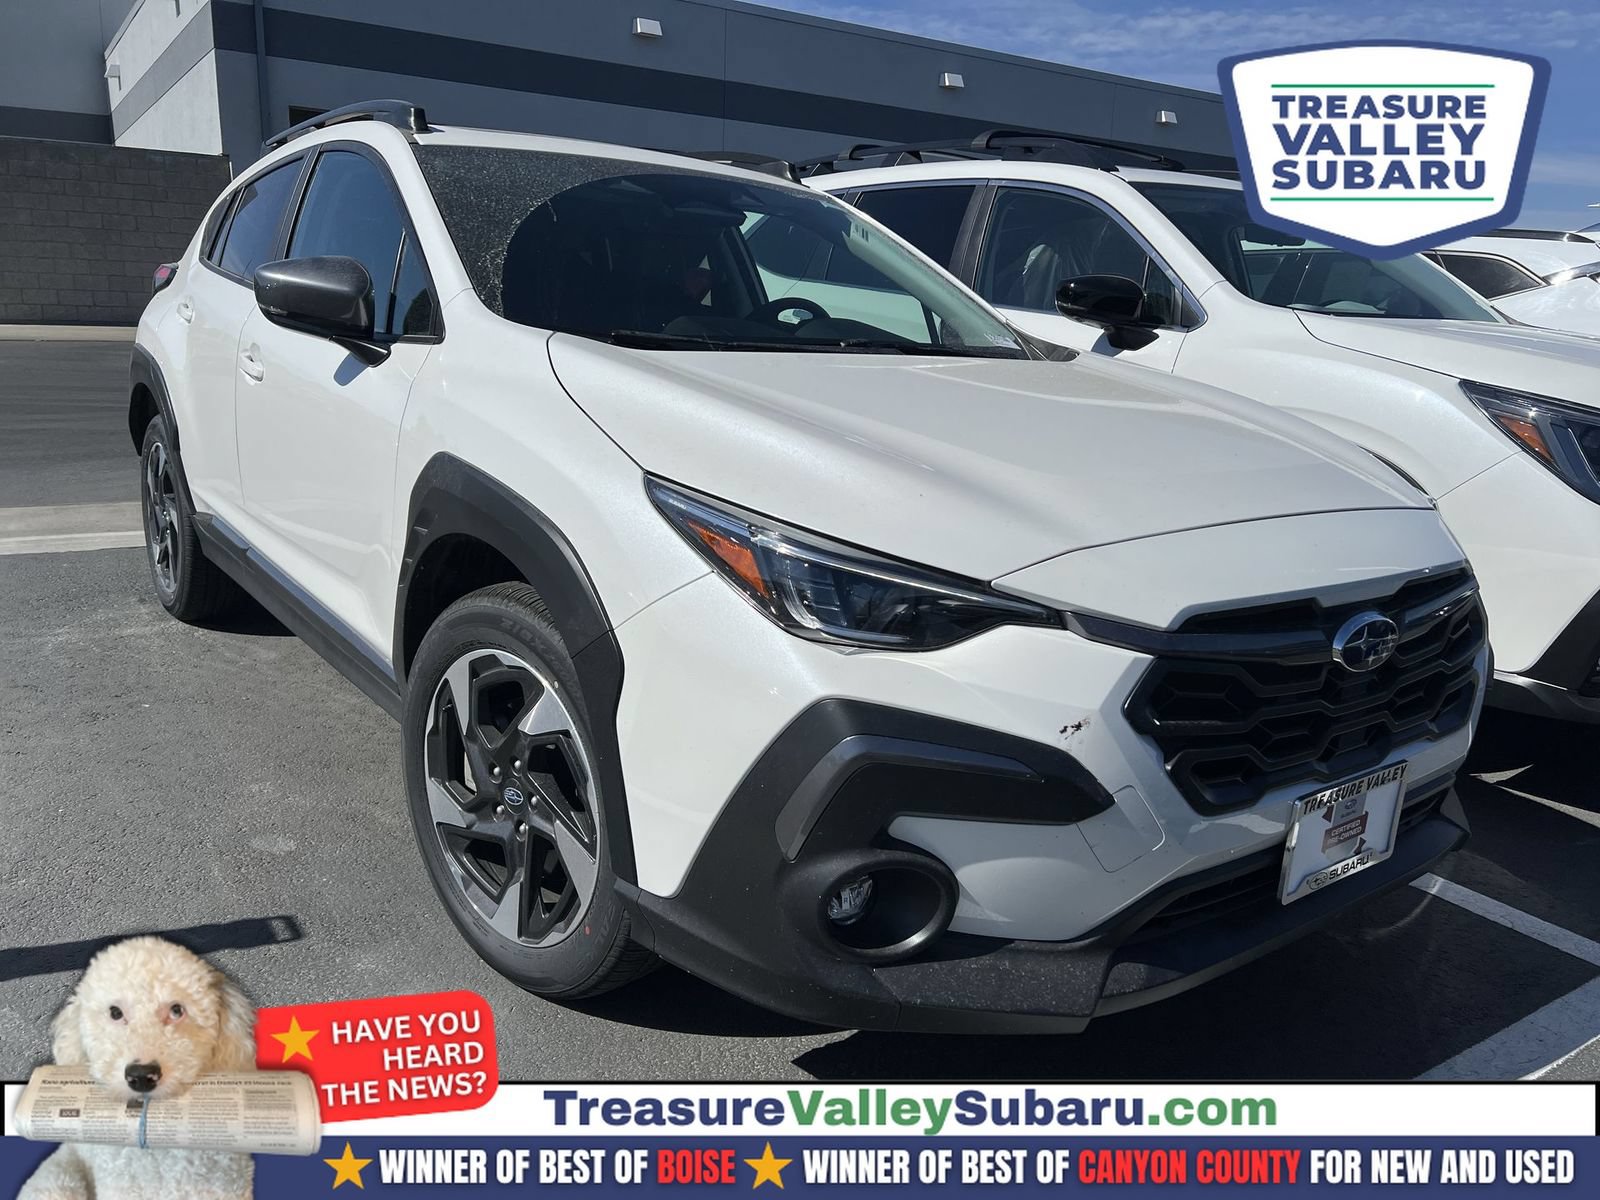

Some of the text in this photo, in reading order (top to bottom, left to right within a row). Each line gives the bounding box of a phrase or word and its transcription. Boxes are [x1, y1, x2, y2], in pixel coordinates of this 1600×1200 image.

[1303, 764, 1408, 815] TREASURE VALLEY
[1328, 856, 1369, 880] SUBARU
